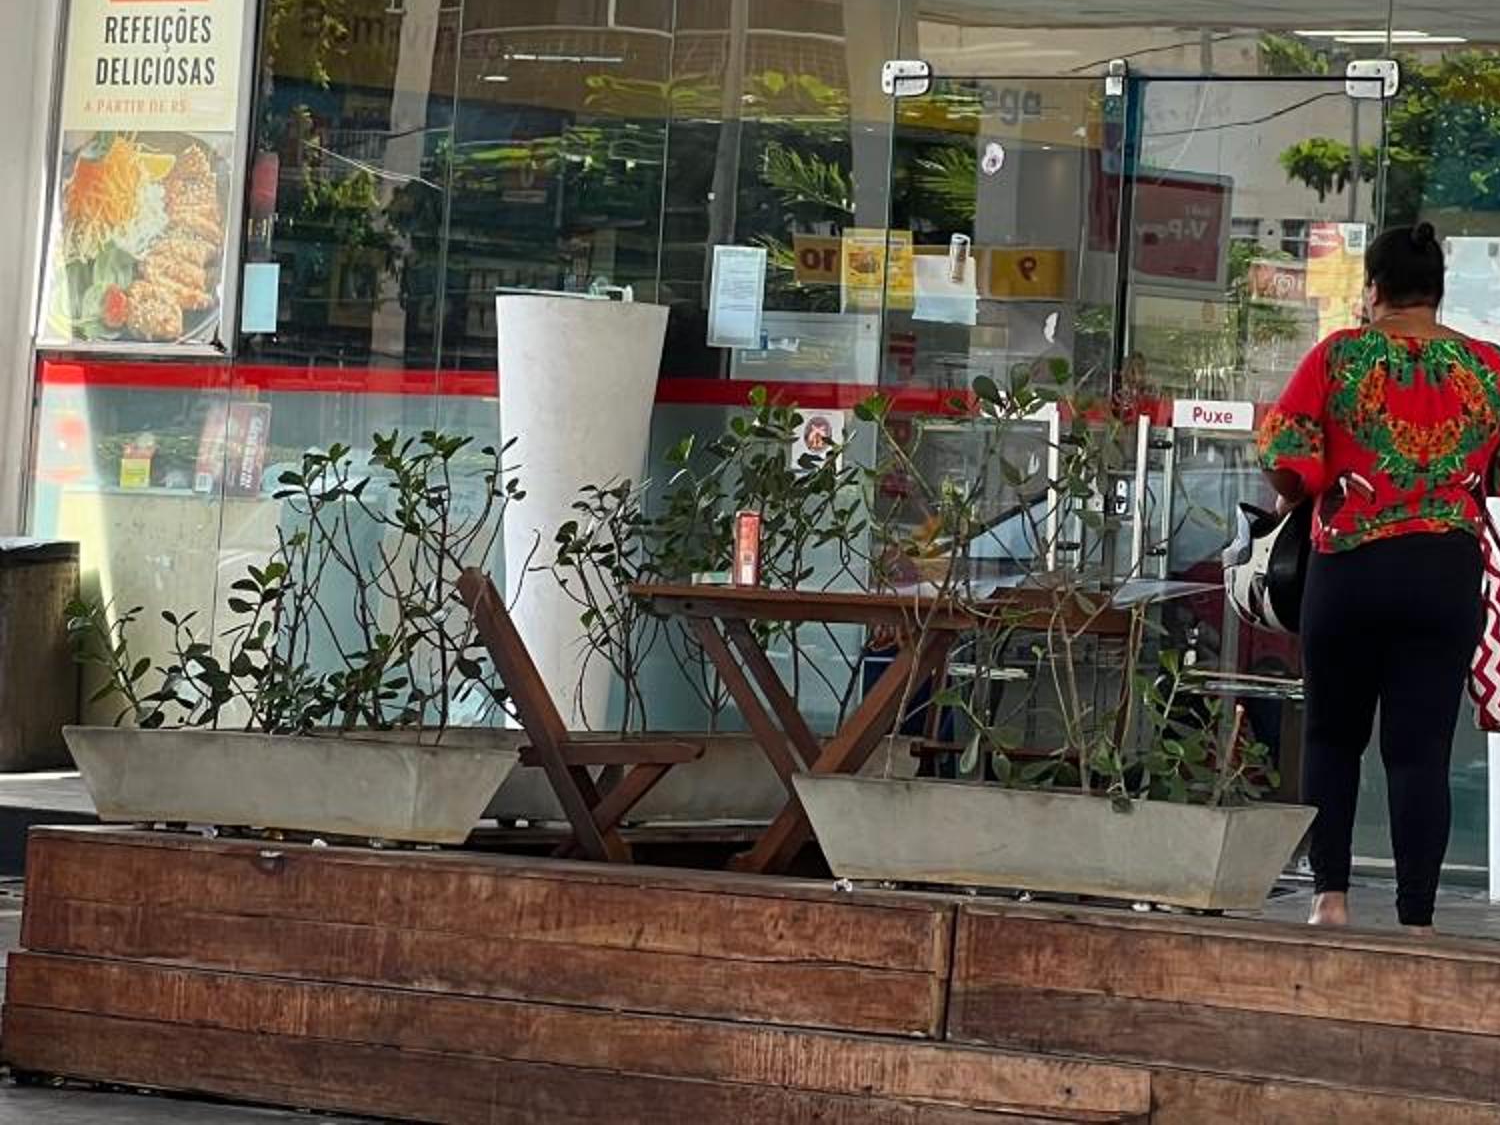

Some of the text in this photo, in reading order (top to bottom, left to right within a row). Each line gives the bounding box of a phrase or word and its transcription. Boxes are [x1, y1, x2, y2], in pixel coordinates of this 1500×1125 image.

[104, 8, 212, 53] REFEIÇÕES
[95, 56, 216, 86] DELICIOSAS
[1192, 406, 1233, 423] Puxe
